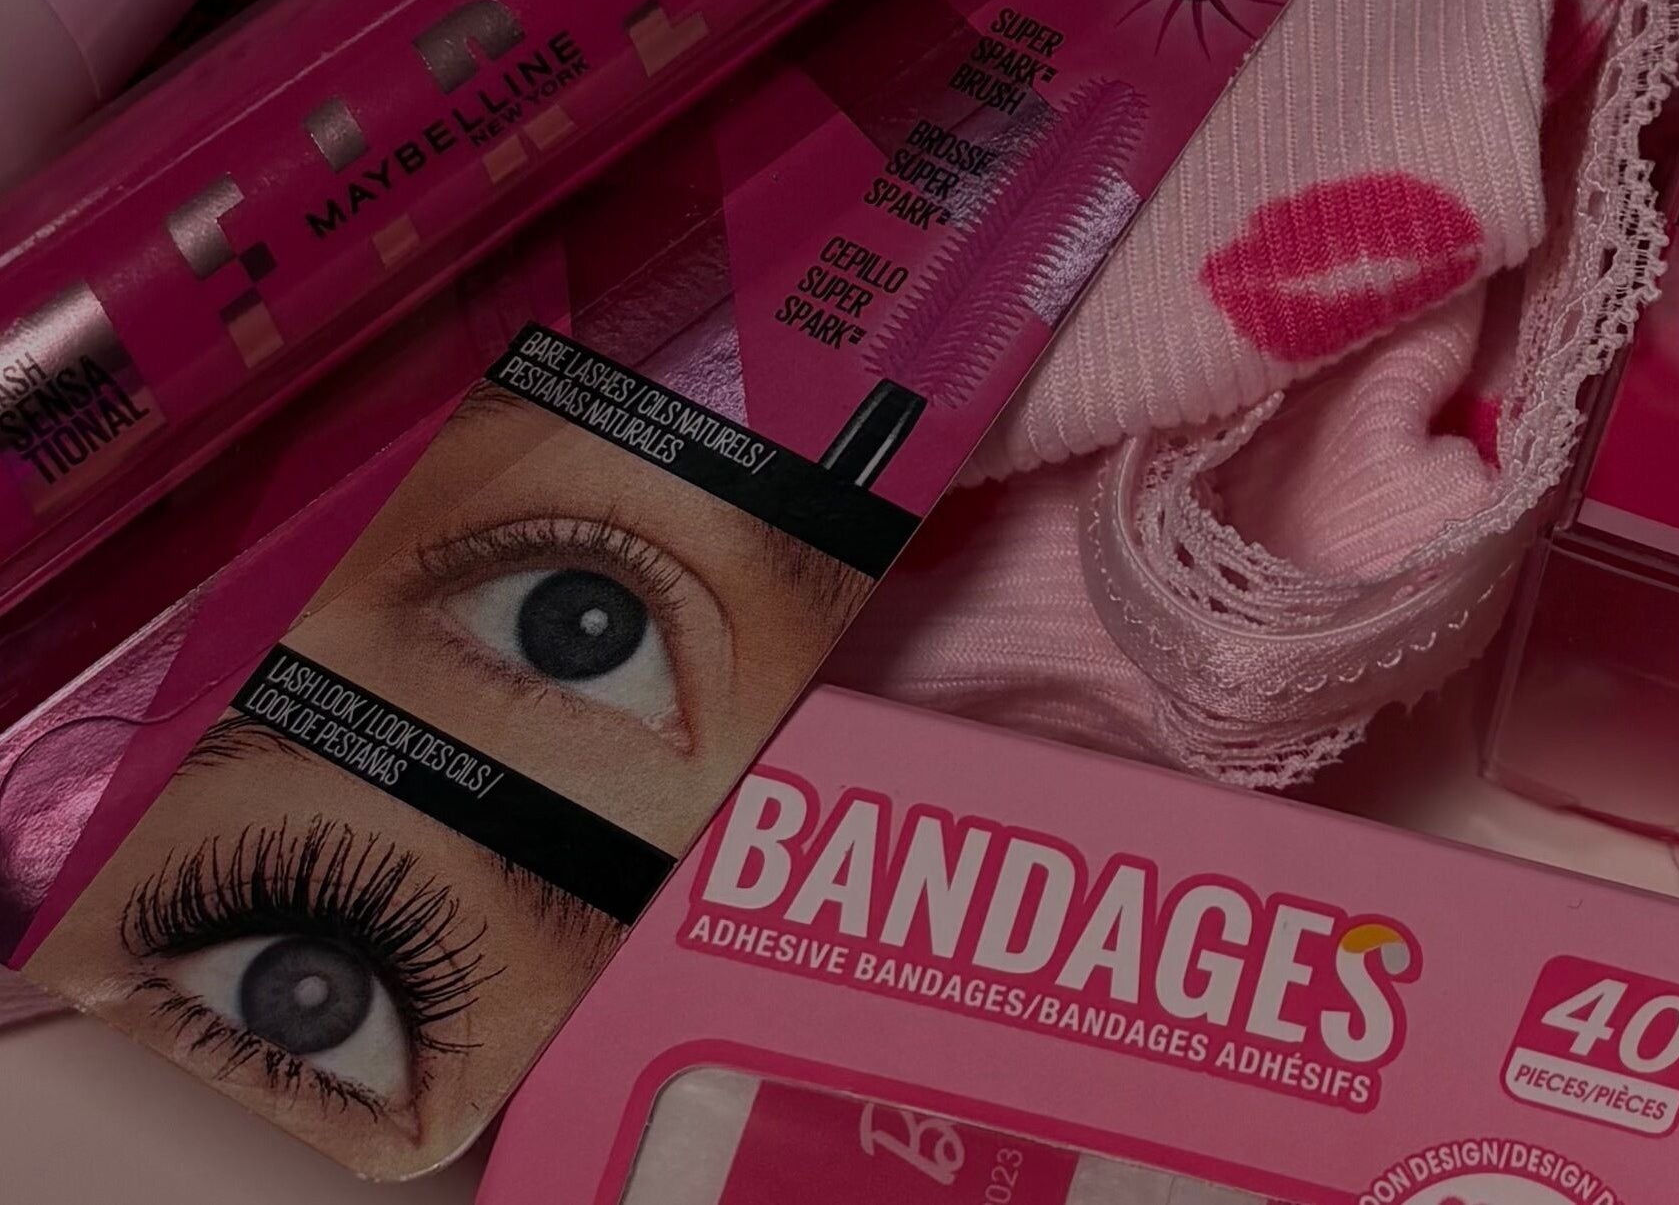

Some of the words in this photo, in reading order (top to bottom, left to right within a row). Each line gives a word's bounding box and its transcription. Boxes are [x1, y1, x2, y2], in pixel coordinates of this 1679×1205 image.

[990, 7, 1065, 58] SUPER
[305, 29, 582, 239] MAYBELLINE
[467, 102, 524, 147] NEW
[525, 56, 591, 106] YORK
[949, 62, 1027, 116] BRUSH
[885, 147, 960, 201] SUPER
[904, 119, 999, 177] BROSSE
[797, 265, 874, 319] SUPER
[819, 236, 909, 294] CEPILLO
[0, 354, 118, 453] SENSA
[21, 385, 151, 485] TIONAL
[499, 355, 591, 418] PESTAÑAS
[580, 400, 685, 466] NATURALES
[519, 330, 575, 371] BARE
[563, 349, 636, 403] LASHES
[637, 388, 682, 427] CILS
[672, 409, 765, 470] NATURELS
[245, 682, 301, 728] LOOK
[288, 706, 326, 742] DE
[312, 720, 408, 787] PESTAÑAS
[267, 654, 318, 696] LASH
[312, 678, 368, 723] LOOK
[363, 708, 423, 755] LOOK
[409, 732, 454, 772] DES
[446, 751, 492, 793] CILS
[702, 773, 1411, 1063] BANDAGES
[688, 915, 850, 975] ADHESIVE
[853, 952, 1210, 1062] BANDAGES/BANDAGES
[1214, 1042, 1372, 1104] ADHÉSIFS
[1513, 1064, 1669, 1121] PIECES/PIÈCES
[1408, 1140, 1601, 1198] DESIGN/DESIGN
